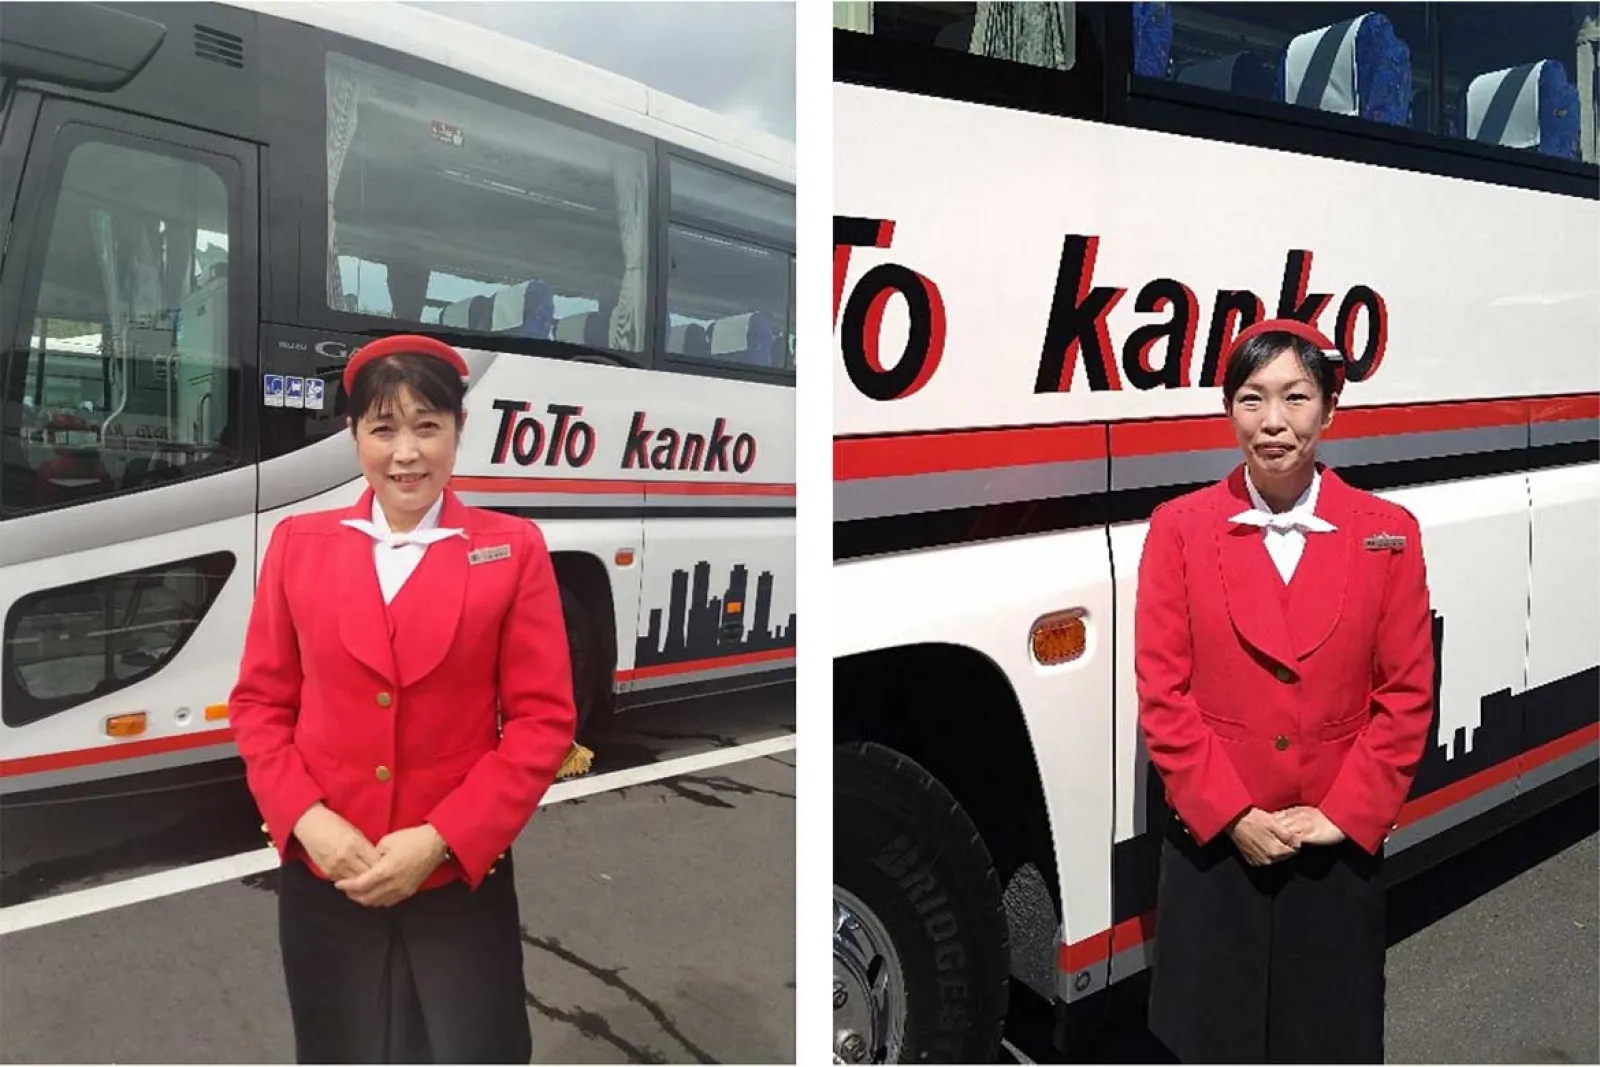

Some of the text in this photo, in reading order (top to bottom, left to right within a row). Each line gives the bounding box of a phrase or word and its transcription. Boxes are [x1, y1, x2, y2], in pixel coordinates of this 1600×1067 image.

[1034, 234, 1388, 394] kanko
[491, 398, 758, 474] ToTo kanko
